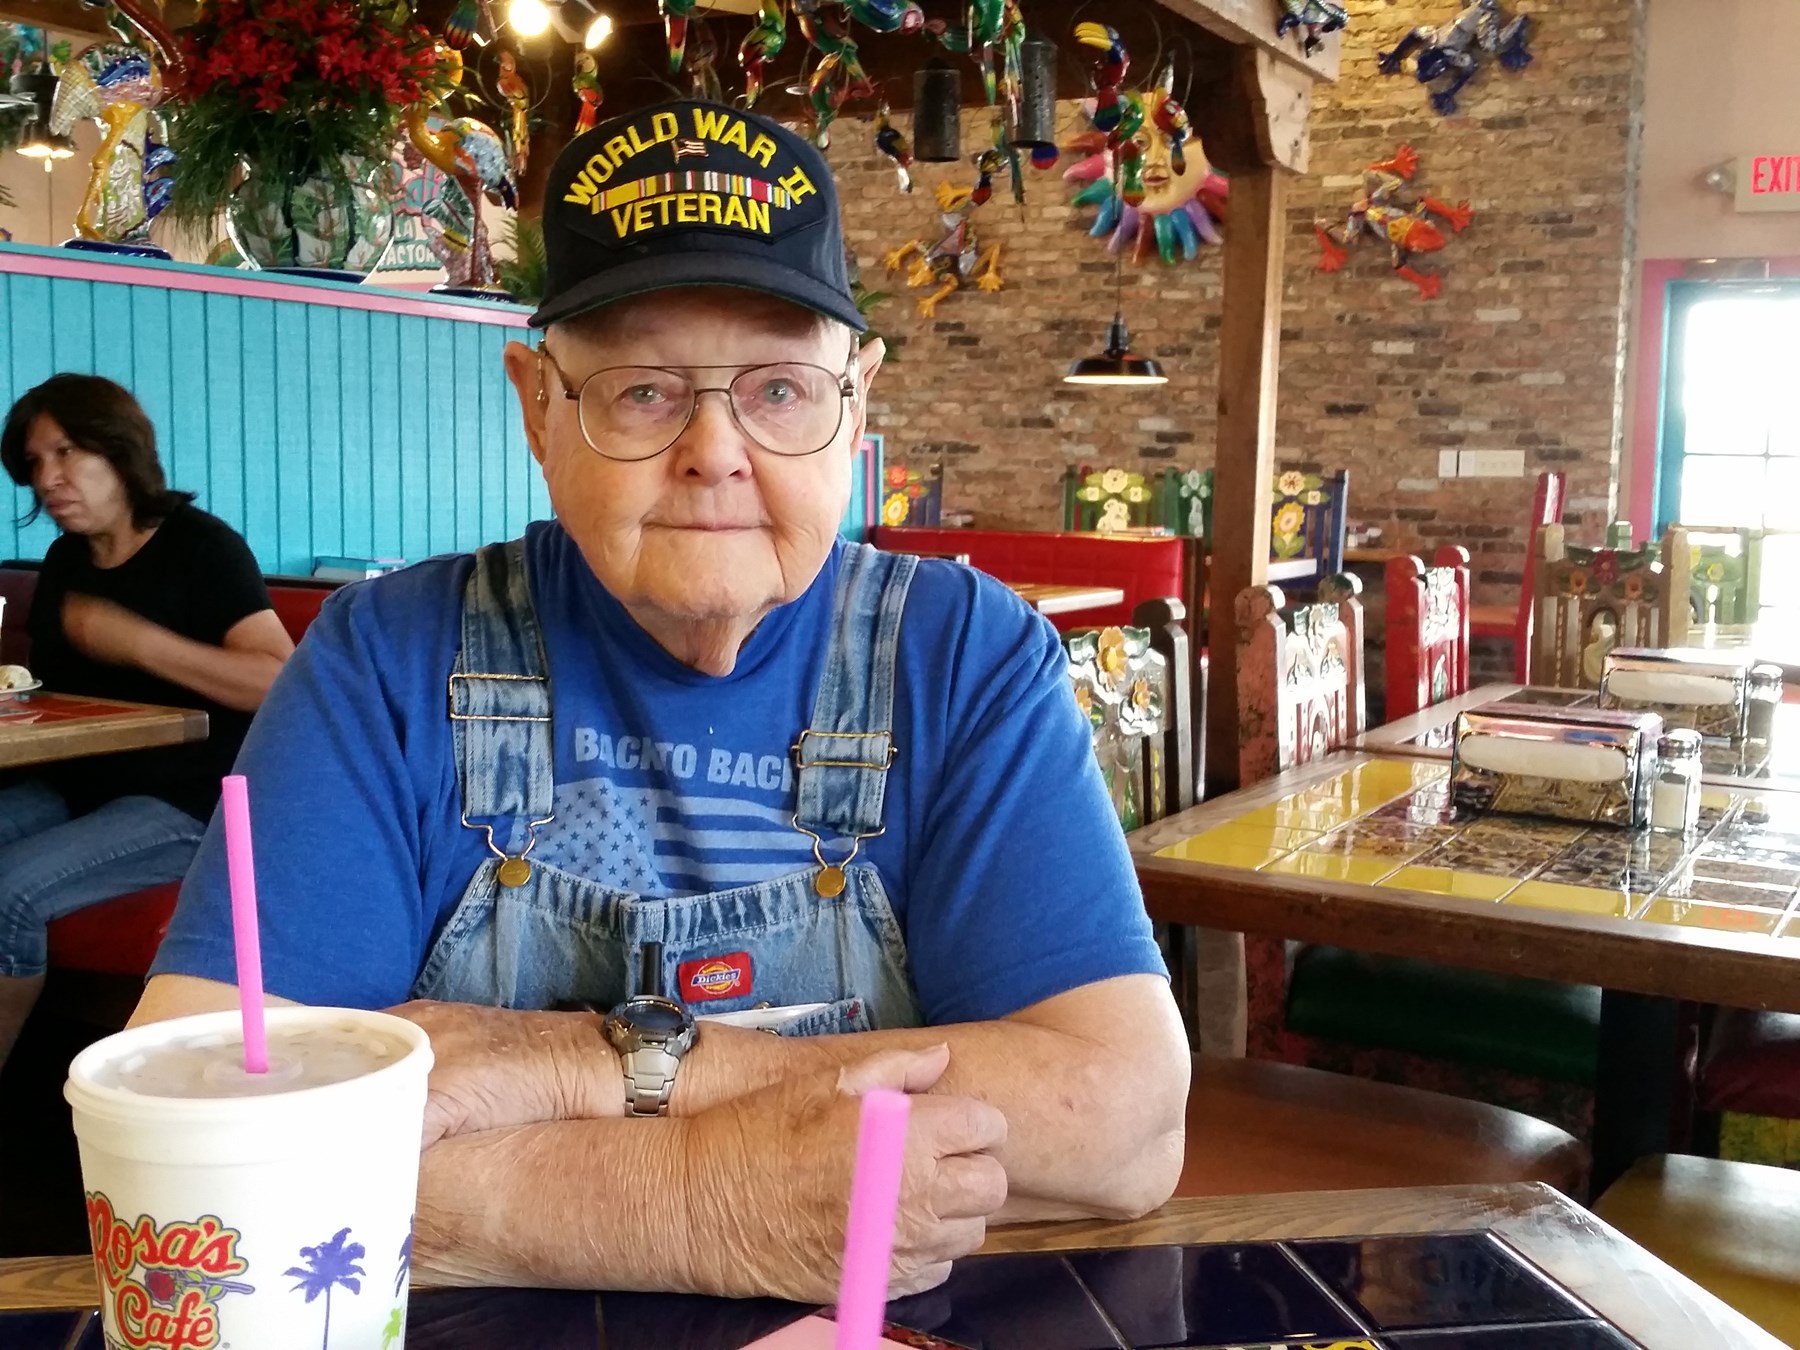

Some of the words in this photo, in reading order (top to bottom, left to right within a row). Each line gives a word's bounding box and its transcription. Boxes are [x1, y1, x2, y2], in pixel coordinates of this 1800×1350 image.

[563, 112, 679, 206] WORLD
[692, 108, 777, 168] WAR
[777, 165, 817, 205] II
[610, 193, 771, 238] VETERAN
[655, 741, 697, 779] TO
[696, 971, 737, 985] Dickies
[117, 1291, 214, 1350] Café
